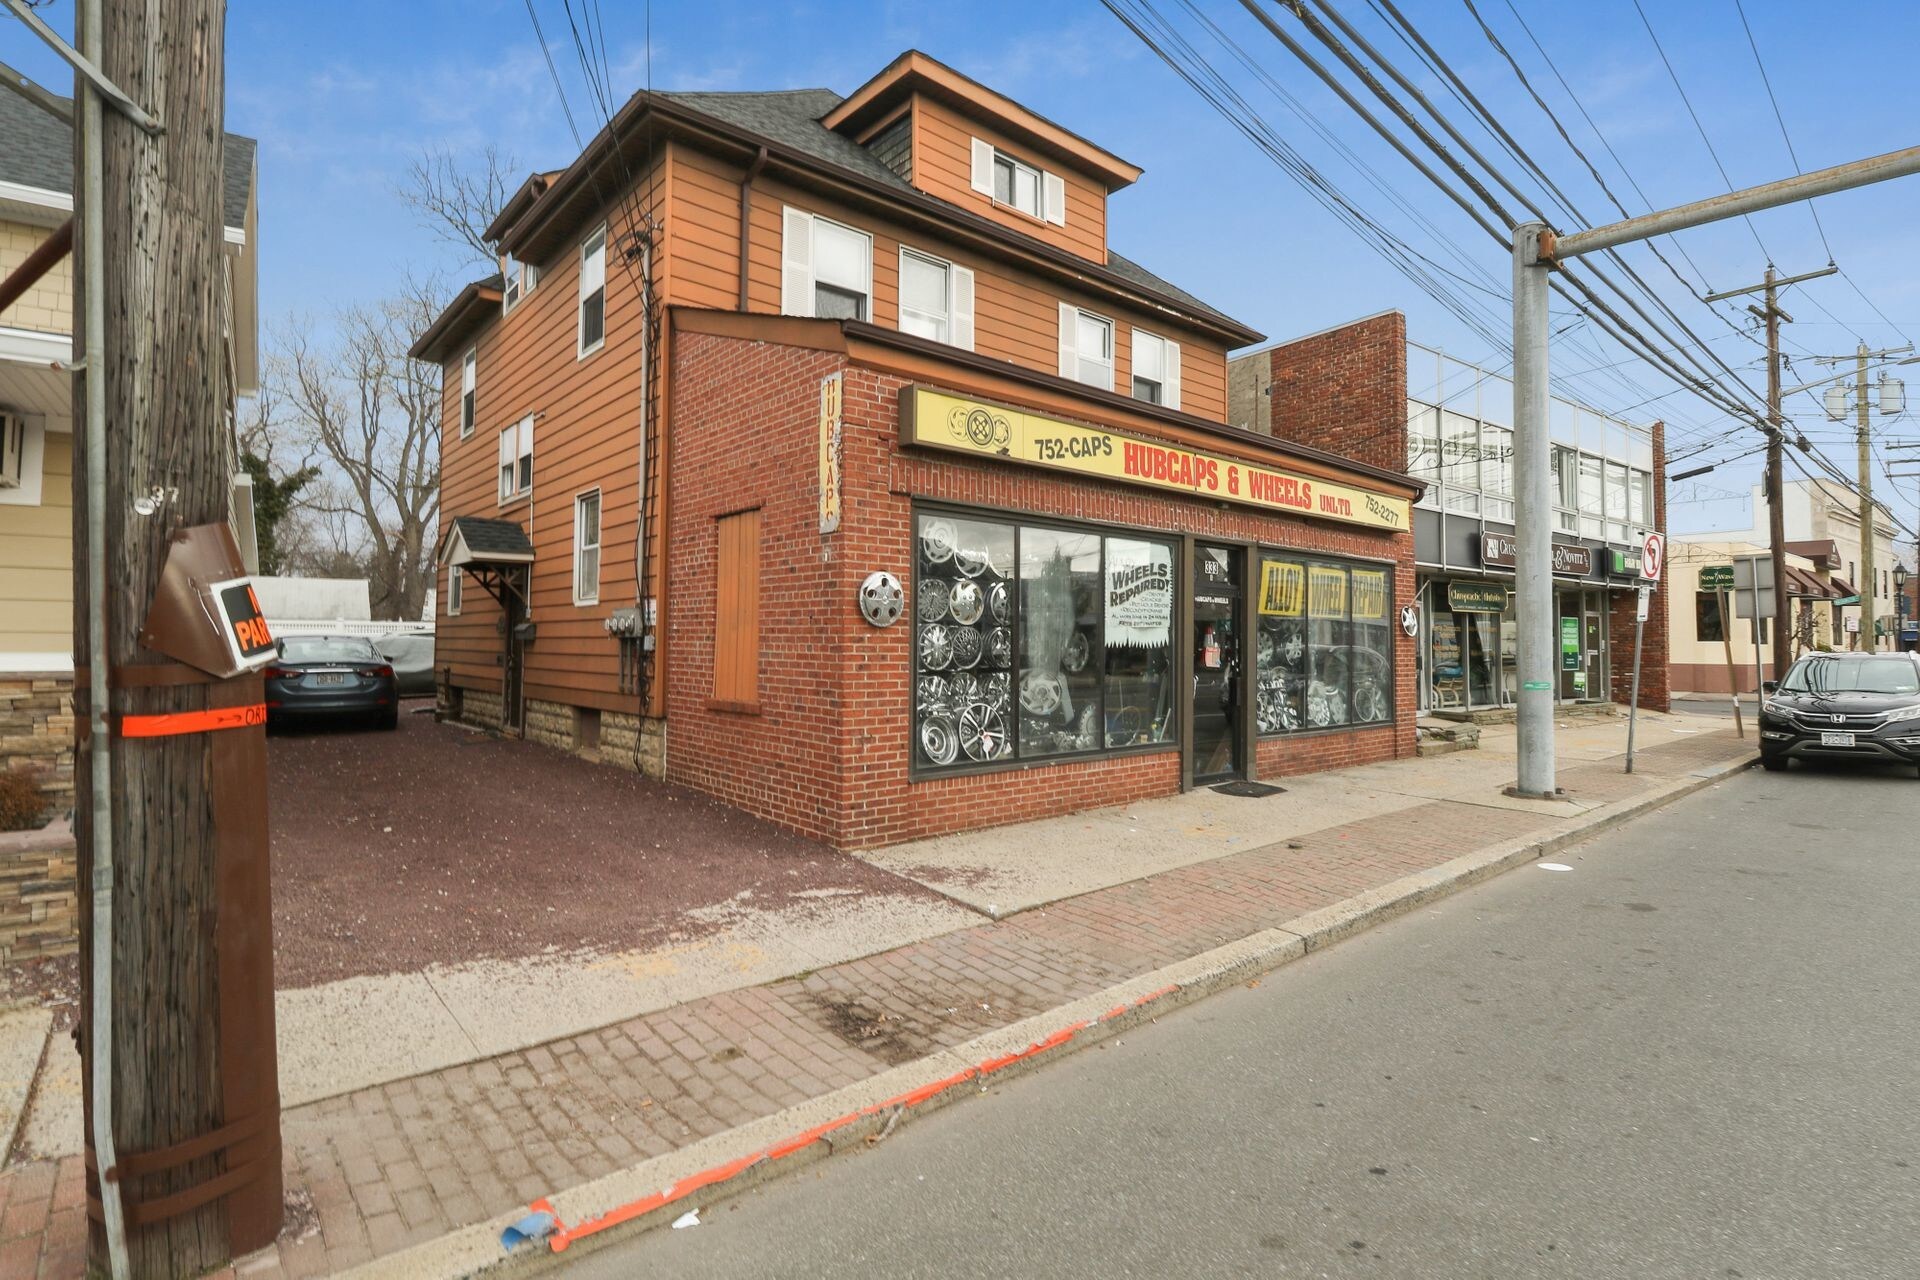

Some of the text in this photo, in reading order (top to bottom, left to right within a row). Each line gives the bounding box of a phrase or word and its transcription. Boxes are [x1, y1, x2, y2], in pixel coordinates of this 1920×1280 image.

[1034, 435, 1399, 526] 752-CAPS HUBCAPS & WHEELS UNLTD. 752-2277
[1112, 563, 1168, 590] WHEELS
[1205, 561, 1218, 574] 333
[1110, 578, 1171, 607] REPAIRED!
[1264, 566, 1301, 612] ALLOY
[1311, 573, 1342, 615] WHEEL
